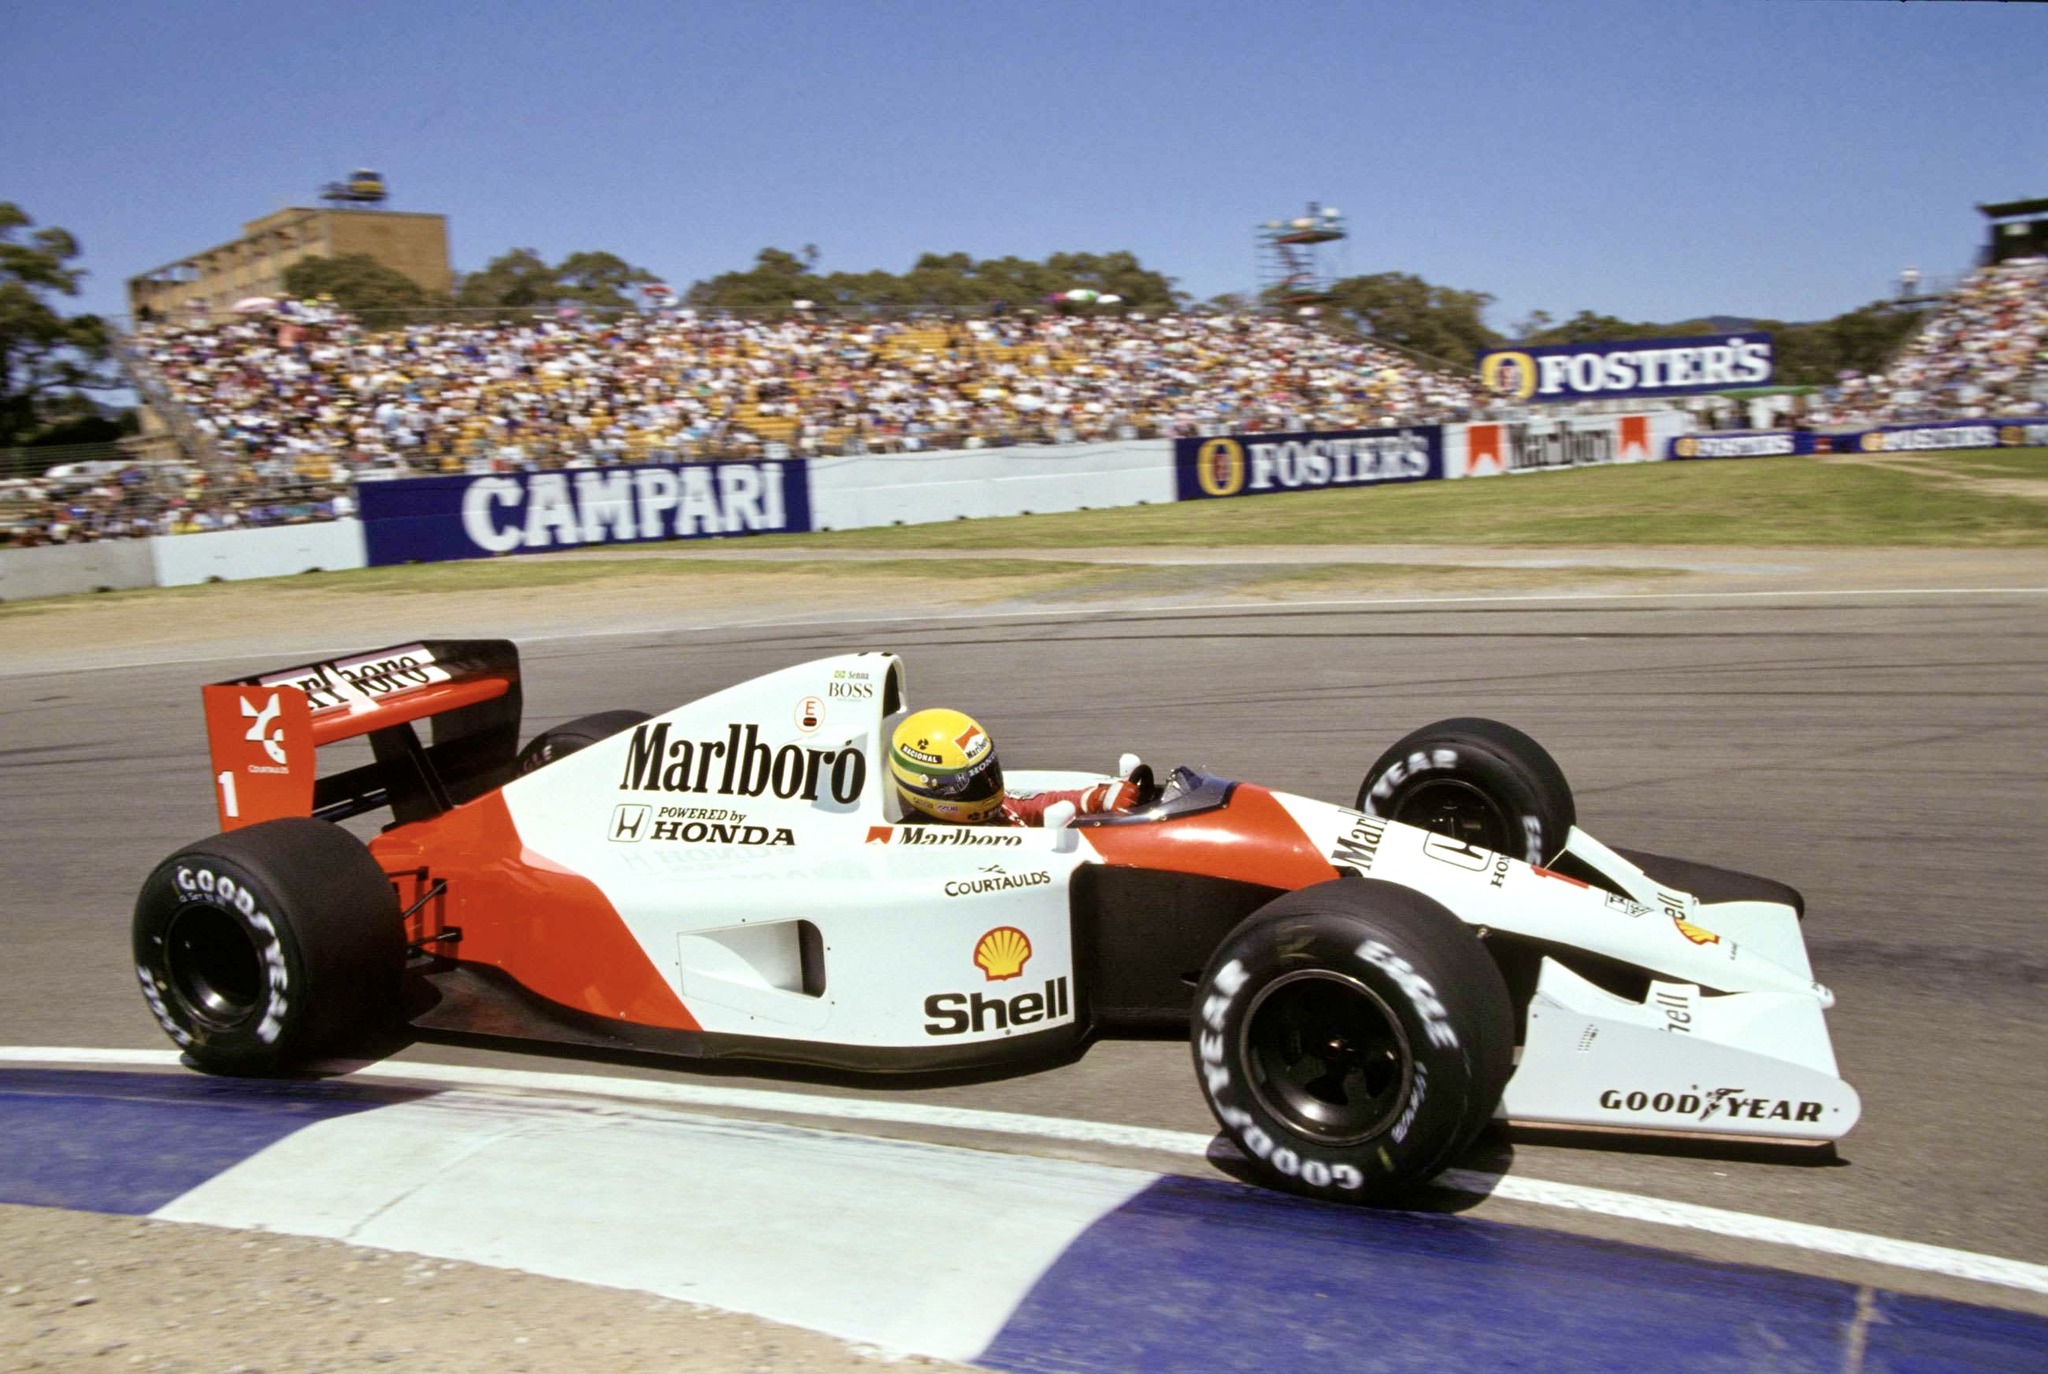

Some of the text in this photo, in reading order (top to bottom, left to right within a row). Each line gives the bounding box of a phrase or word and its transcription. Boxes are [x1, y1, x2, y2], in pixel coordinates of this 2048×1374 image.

[1536, 338, 1772, 394] FOSTER'S
[1248, 430, 1430, 488] FOSTER'S
[461, 462, 786, 552] CAMPARI
[276, 656, 431, 709] rlboro
[828, 682, 874, 699] BOSS
[619, 722, 867, 805] Marlboro
[902, 745, 939, 763] NACIONAL
[217, 770, 239, 818] 1
[658, 806, 747, 824] POWERED by
[650, 821, 797, 846] HONDA
[898, 827, 1023, 847] Marlboro
[1331, 808, 1388, 871] Marl
[945, 870, 1051, 897] COURTAULDS
[1657, 892, 1686, 921] ell
[924, 976, 1068, 1036] Shell
